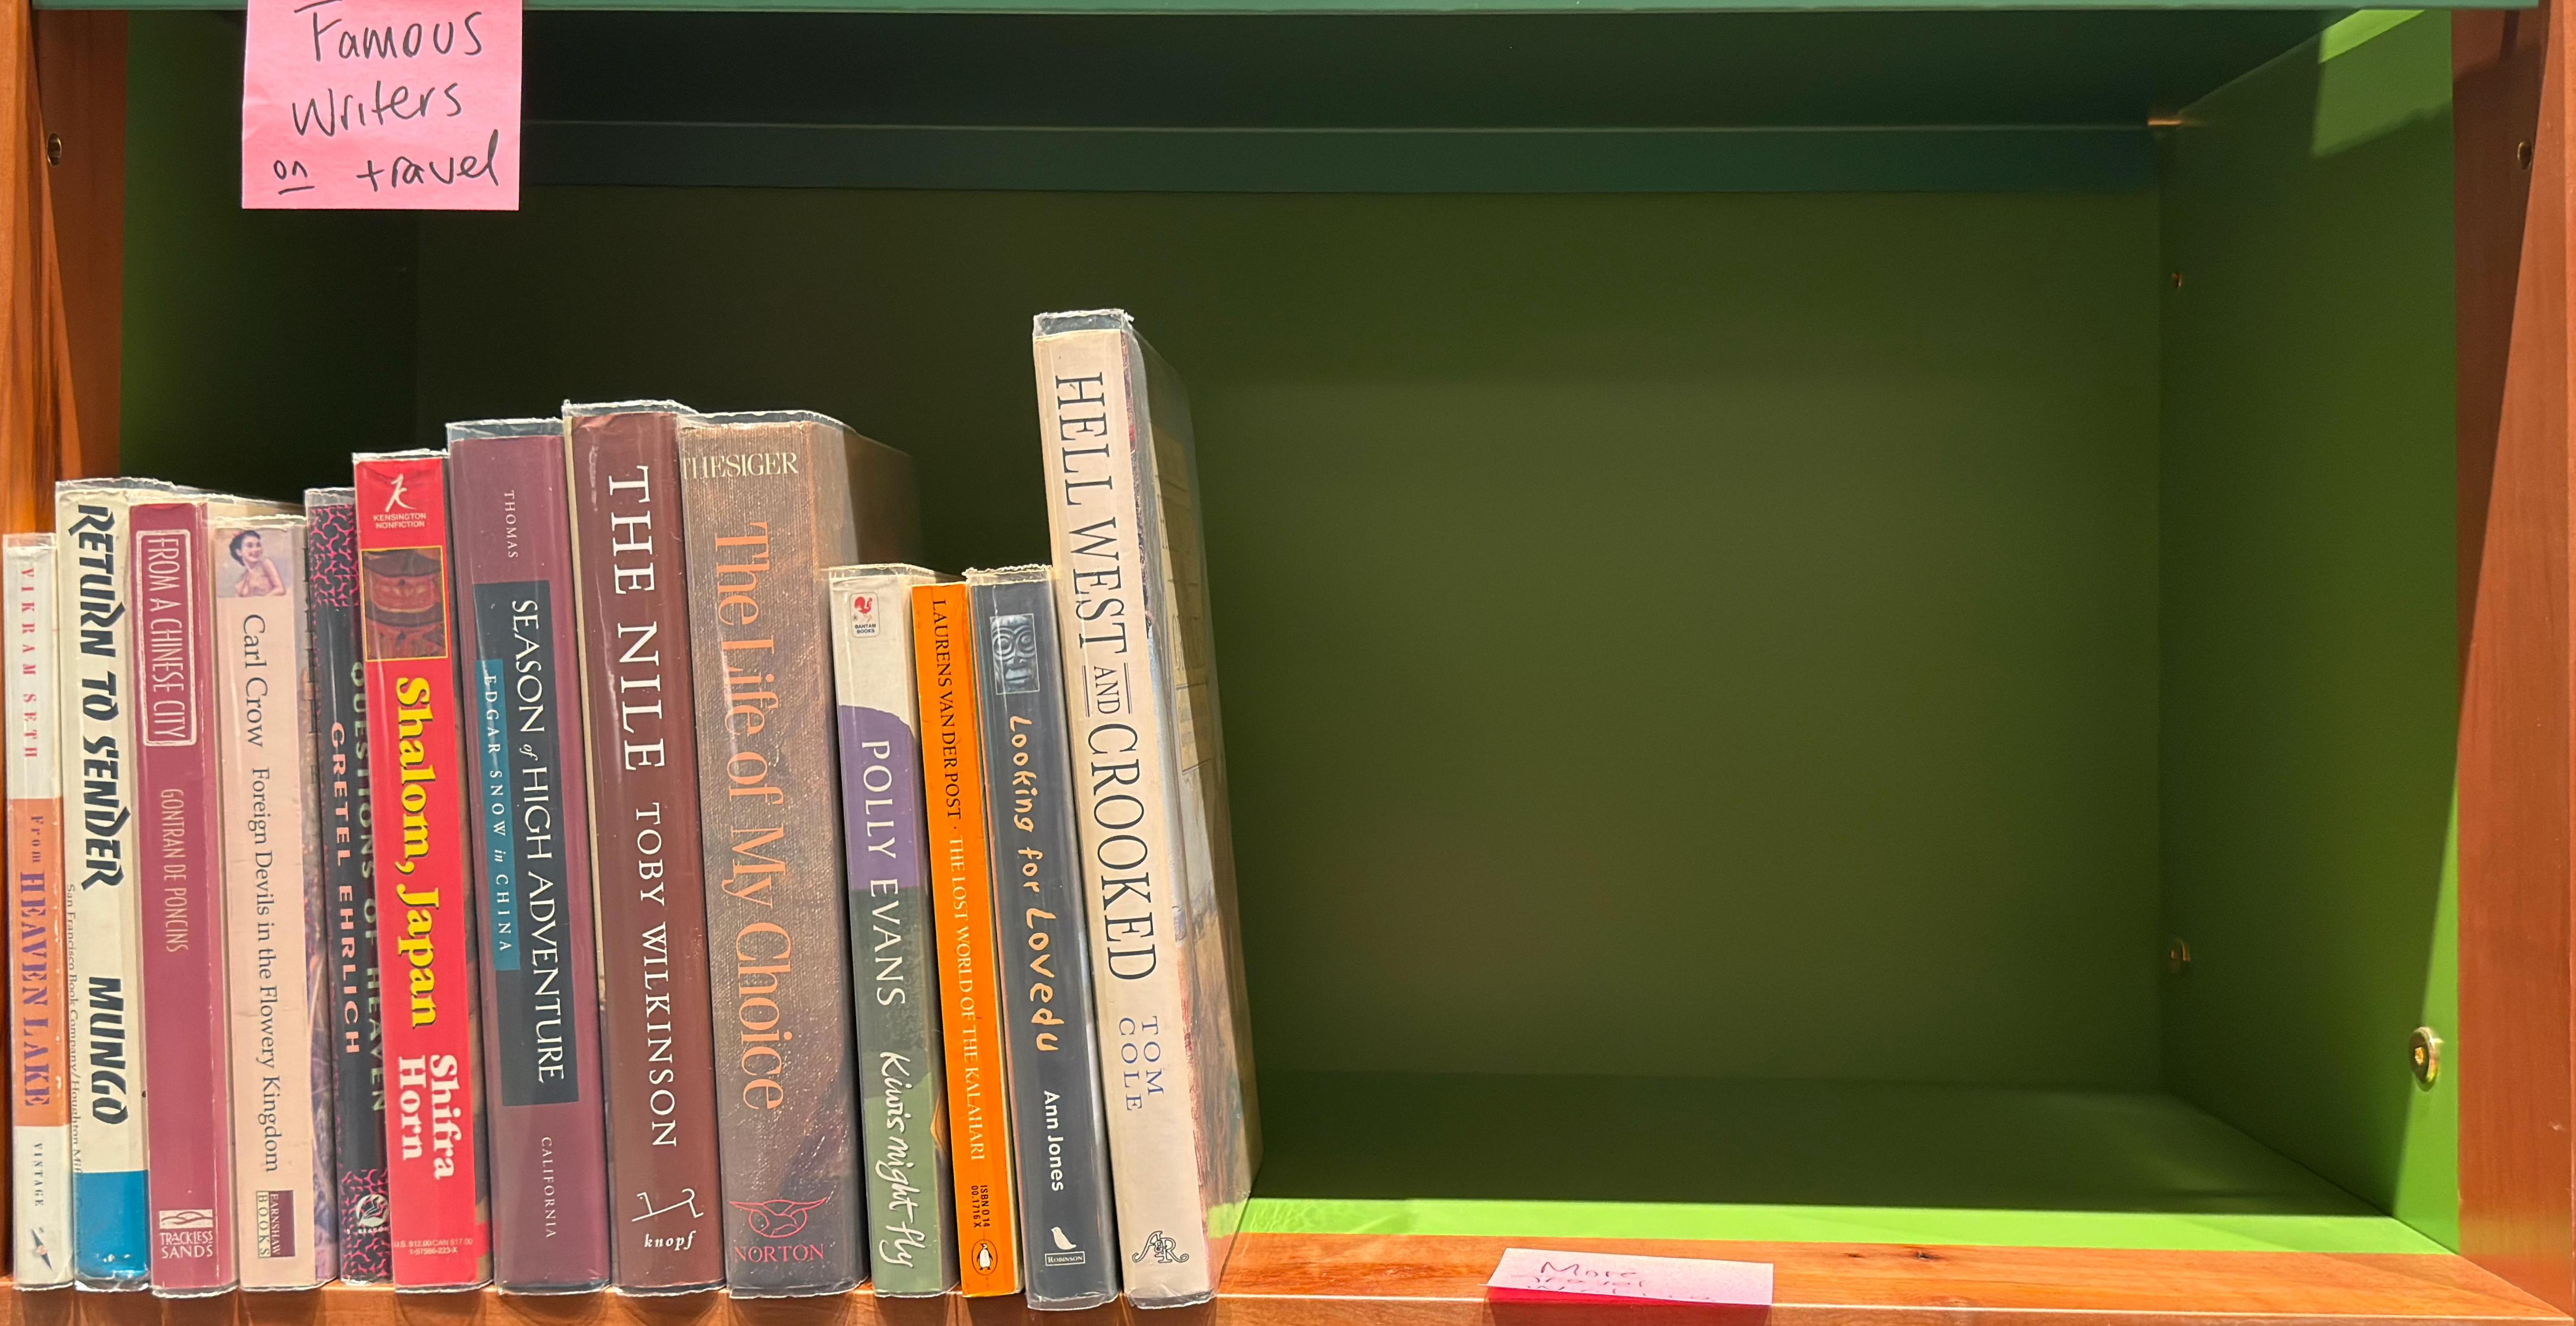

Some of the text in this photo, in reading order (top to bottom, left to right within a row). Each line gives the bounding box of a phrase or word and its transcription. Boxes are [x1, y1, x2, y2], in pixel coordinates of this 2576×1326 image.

[294, 0, 481, 61] Famous
[292, 81, 462, 136] Writers
[274, 129, 498, 192] on travel
[374, 513, 427, 521] KENSINGTON
[376, 521, 425, 529] NONFICTION
[504, 490, 518, 558] THOMAS
[21, 567, 38, 758] VIKRAM SETH
[147, 538, 186, 739] FROM A CHINESE CITY
[242, 614, 268, 748] Carl Crow
[1056, 372, 1157, 981] HELL WEST AND CROOKED
[933, 599, 961, 820] LAURENS VAN DER POST
[68, 505, 131, 1124] RETURN TO SENDER MUNGO
[395, 677, 440, 1028] Shalom, Japan
[485, 675, 512, 951] EDGAR SNOW in CHINA
[512, 600, 564, 1083] SEASON of HIGH ADVENTURE
[608, 465, 676, 1147] THE NILE TOBY WILKINSON
[715, 521, 792, 1110] The Life of My Choice
[67, 883, 75, 907] San
[161, 788, 189, 953] GONTRAN DE PONCINS
[332, 722, 360, 1053] GRETEL EHRLICH
[861, 741, 905, 1006] POLLY EVANS
[1010, 716, 1065, 1052] Looking for Lovedu
[20, 815, 50, 1107] From HEAVEN LAKE
[67, 911, 76, 971] Francisco
[69, 974, 78, 1007] Book
[248, 767, 282, 1173] Foreign Devils in the Flowery Kingdom
[949, 836, 986, 1161] THE LOST WORLD OF THE KALAHARI
[1118, 1016, 1143, 1111] COLE
[1141, 1015, 1165, 1095] TOM
[399, 1055, 426, 1161] Horn
[430, 1054, 462, 1180] Shifra
[1044, 1091, 1064, 1192] Ann Jones
[34, 1143, 44, 1206] VINTAGE
[541, 1137, 557, 1238] CALIFORNIA
[875, 1052, 925, 1269] Kiwis might fly
[980, 1185, 989, 1208] ISBN
[159, 1231, 213, 1246] TRACKLESS
[161, 1244, 213, 1259] SANDS
[258, 1195, 270, 1255] BOOKS
[270, 1193, 281, 1255] EARNSHAW
[644, 1231, 697, 1251] knopf
[734, 1244, 824, 1263] NORTON
